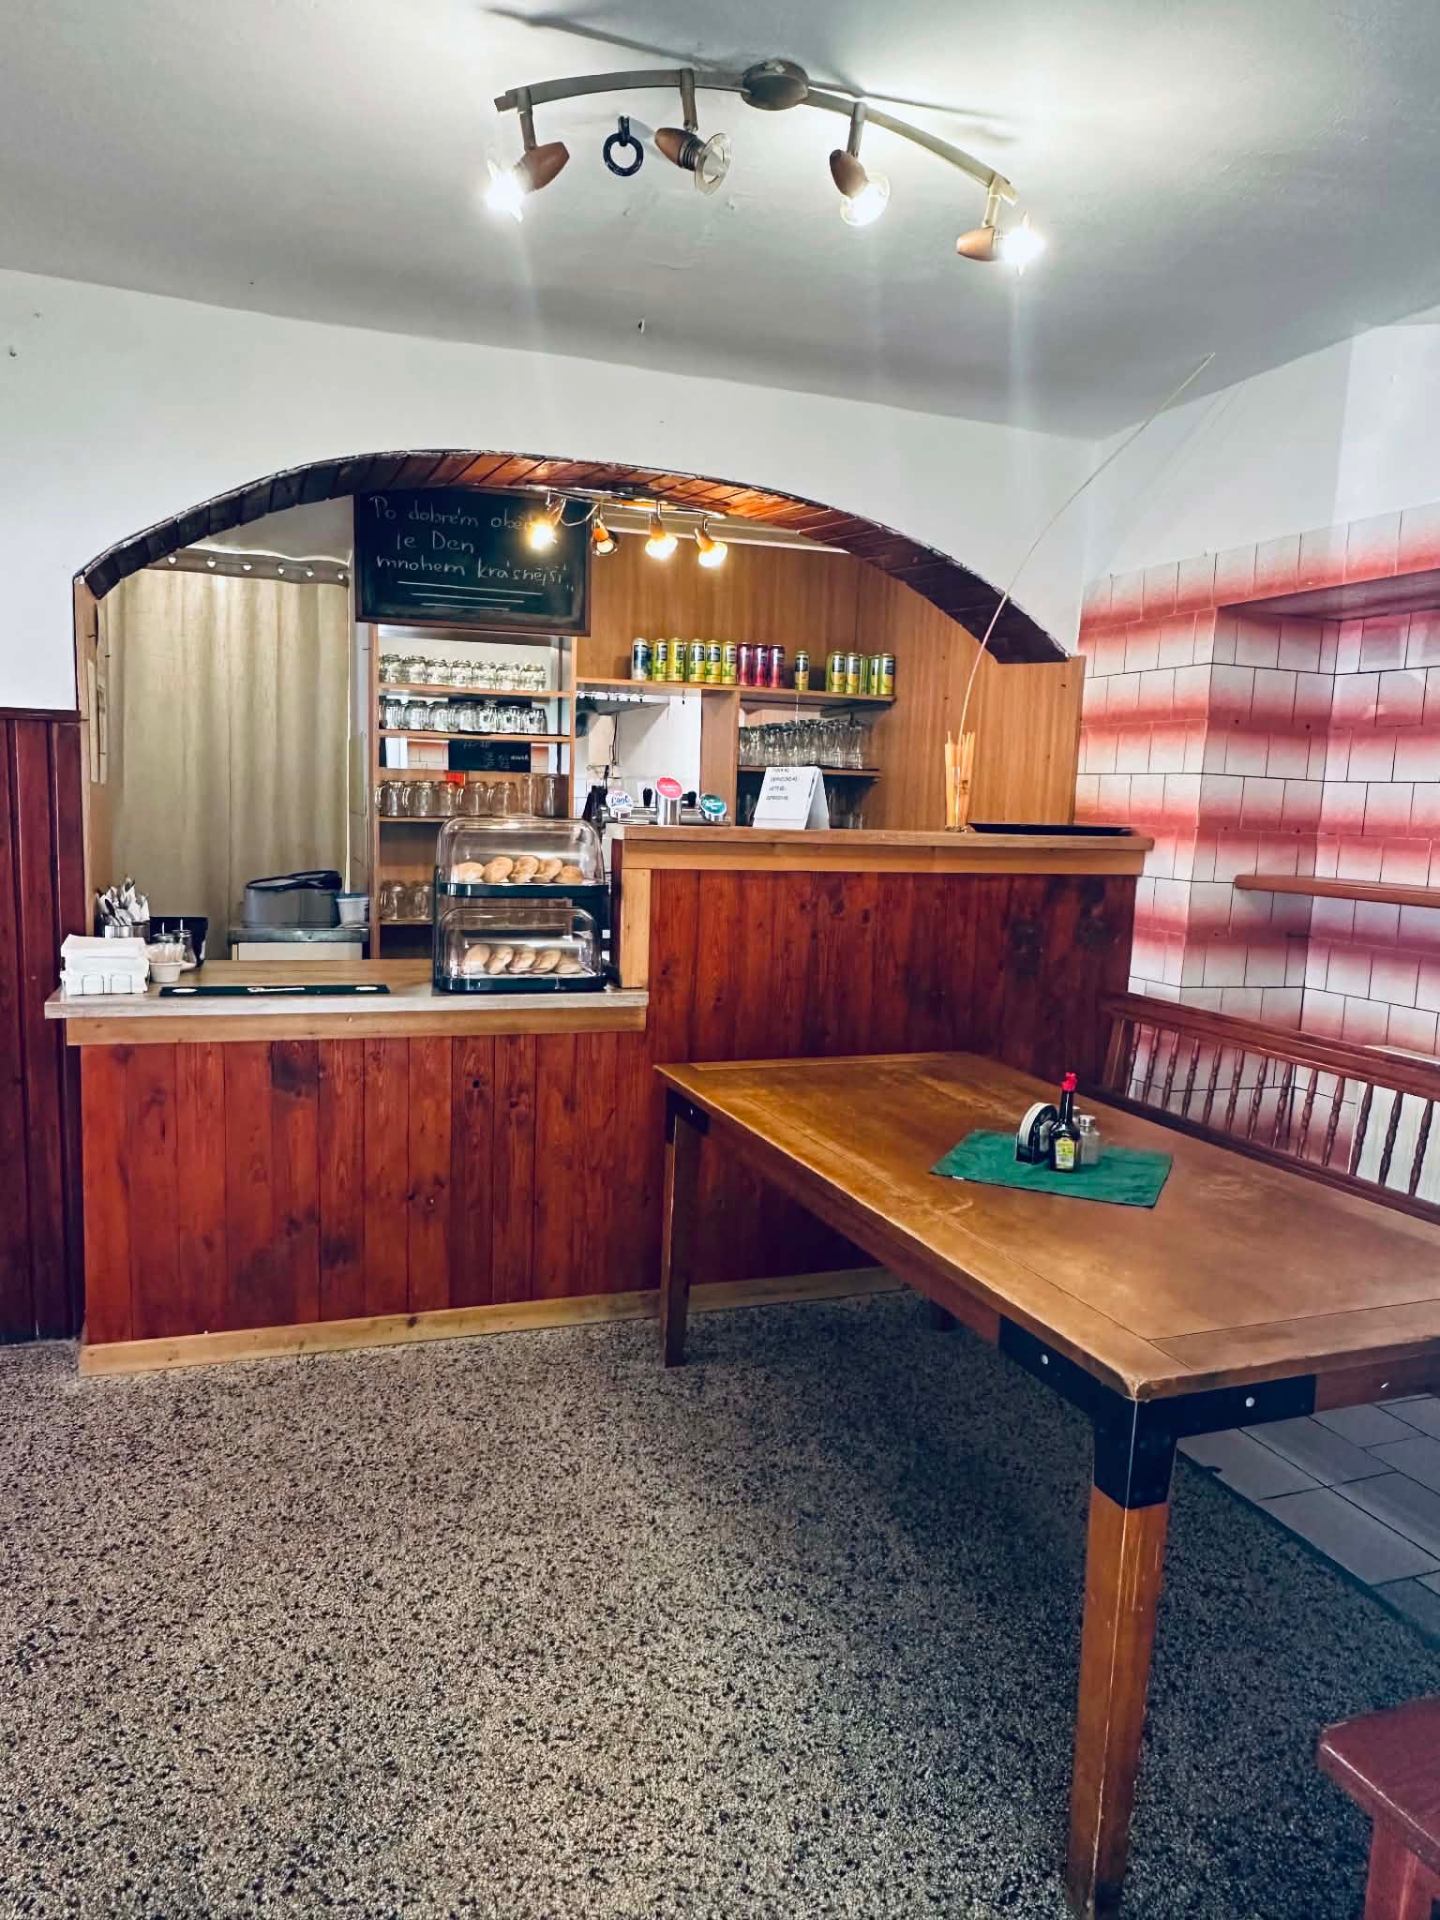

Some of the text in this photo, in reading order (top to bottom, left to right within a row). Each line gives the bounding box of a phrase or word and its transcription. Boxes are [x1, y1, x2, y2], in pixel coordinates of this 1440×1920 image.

[368, 495, 397, 520] Po
[408, 499, 480, 527] dobrém
[432, 530, 475, 554] Den
[376, 553, 466, 577] mnohem
